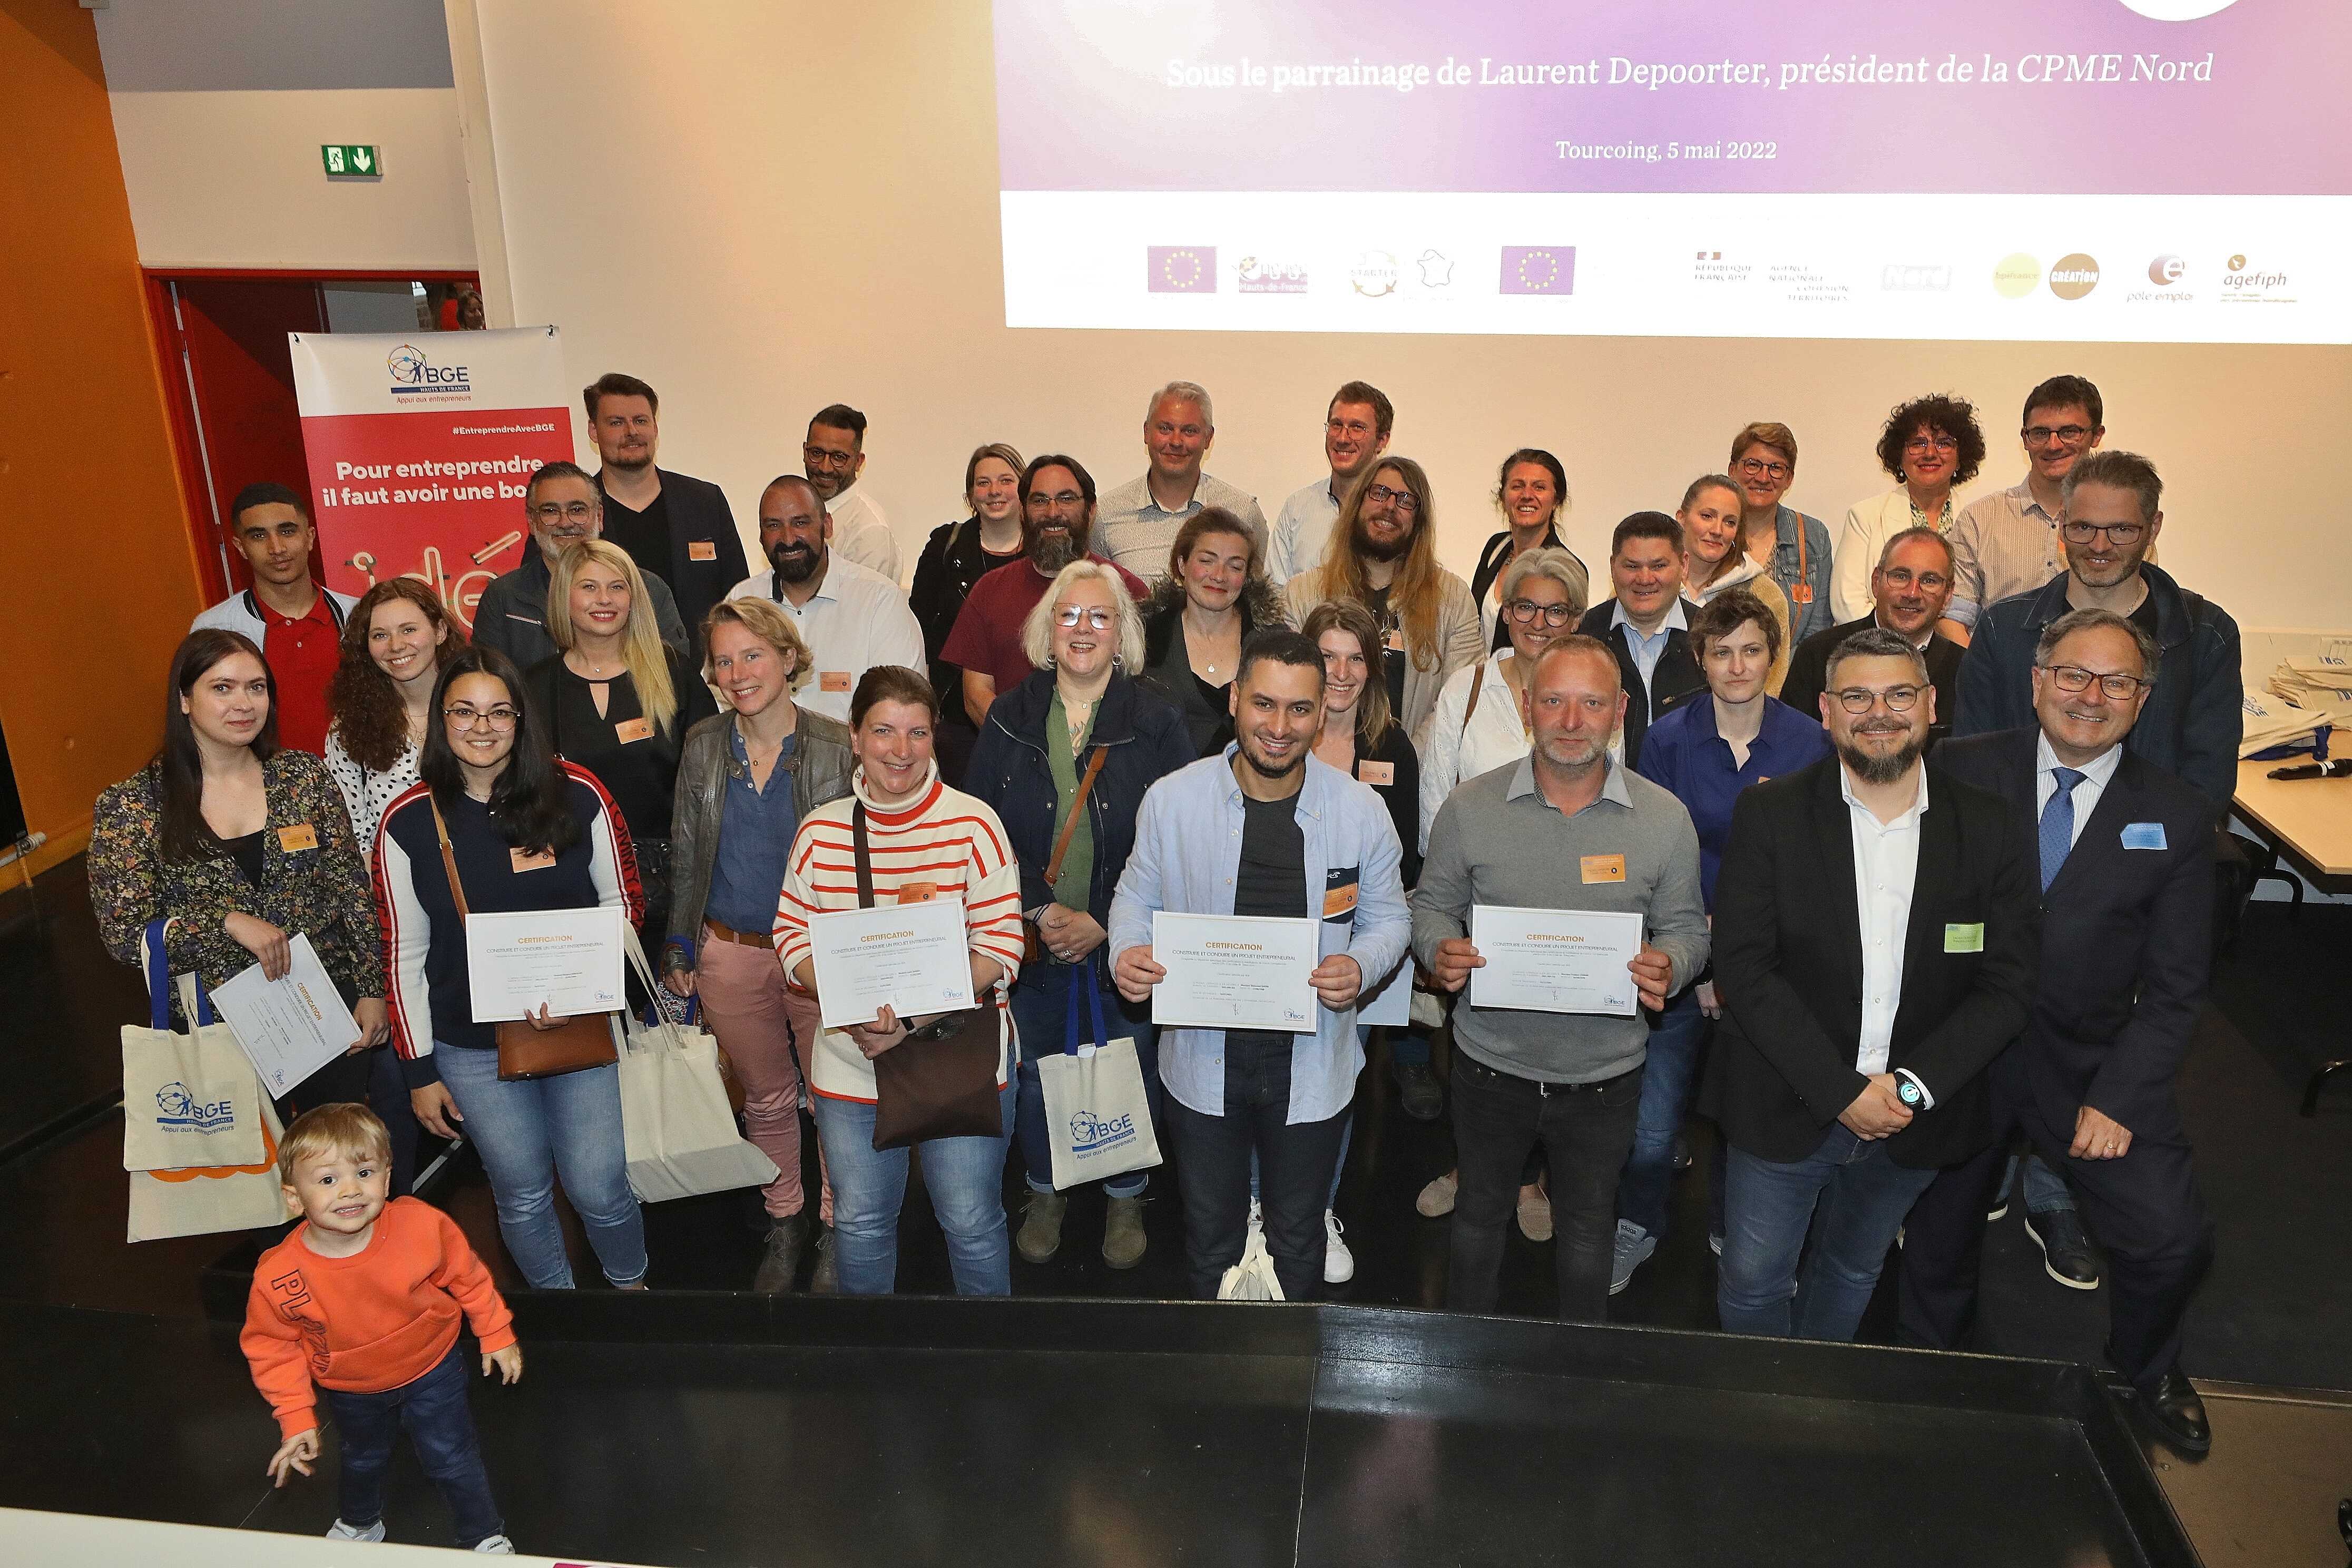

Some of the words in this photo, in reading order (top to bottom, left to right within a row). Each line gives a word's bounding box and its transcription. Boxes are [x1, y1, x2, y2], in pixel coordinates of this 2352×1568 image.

[1164, 58, 1235, 87] Sous
[1240, 57, 1268, 85] le
[1272, 58, 1430, 93] parrainage
[1437, 57, 1472, 85] de
[1479, 57, 1600, 85] Laurent
[1608, 57, 1771, 91] Depoorter,
[1778, 54, 1929, 90] président
[1936, 54, 1973, 83] de
[1981, 54, 2008, 82] la
[2017, 54, 2122, 82] CPME
[2129, 53, 2214, 82] Nord
[1556, 141, 1662, 164] Tourcoing,
[1667, 141, 1679, 159] 5
[1685, 140, 1721, 159] mai
[1727, 141, 1777, 159] 2022
[2224, 271, 2287, 289] agefiph
[426, 367, 469, 383] BGE
[397, 396, 414, 405] Appui
[452, 423, 555, 435] #EntreprendreAvecBGE
[336, 461, 391, 481] Pour
[396, 455, 544, 480] entreprendre
[322, 488, 337, 507] il
[341, 486, 389, 506] faut
[394, 482, 447, 504] avoir
[453, 485, 494, 501] une
[498, 480, 527, 499] bo
[518, 936, 572, 944] CERTIFICATION
[861, 930, 914, 943] CERTIFICATION
[1206, 942, 1262, 950] CERTIFICATION
[297, 982, 323, 1021] CERTIFICATION
[193, 1101, 232, 1120] BGE
[194, 1125, 234, 1136] entrepreneurs
[1098, 1113, 1133, 1138] BGE
[1096, 1139, 1110, 1147] HAUTS
[1117, 1130, 1134, 1139] FRANCE
[1077, 1152, 1092, 1160] Appui
[1103, 1136, 1136, 1152] entrepreneurs
